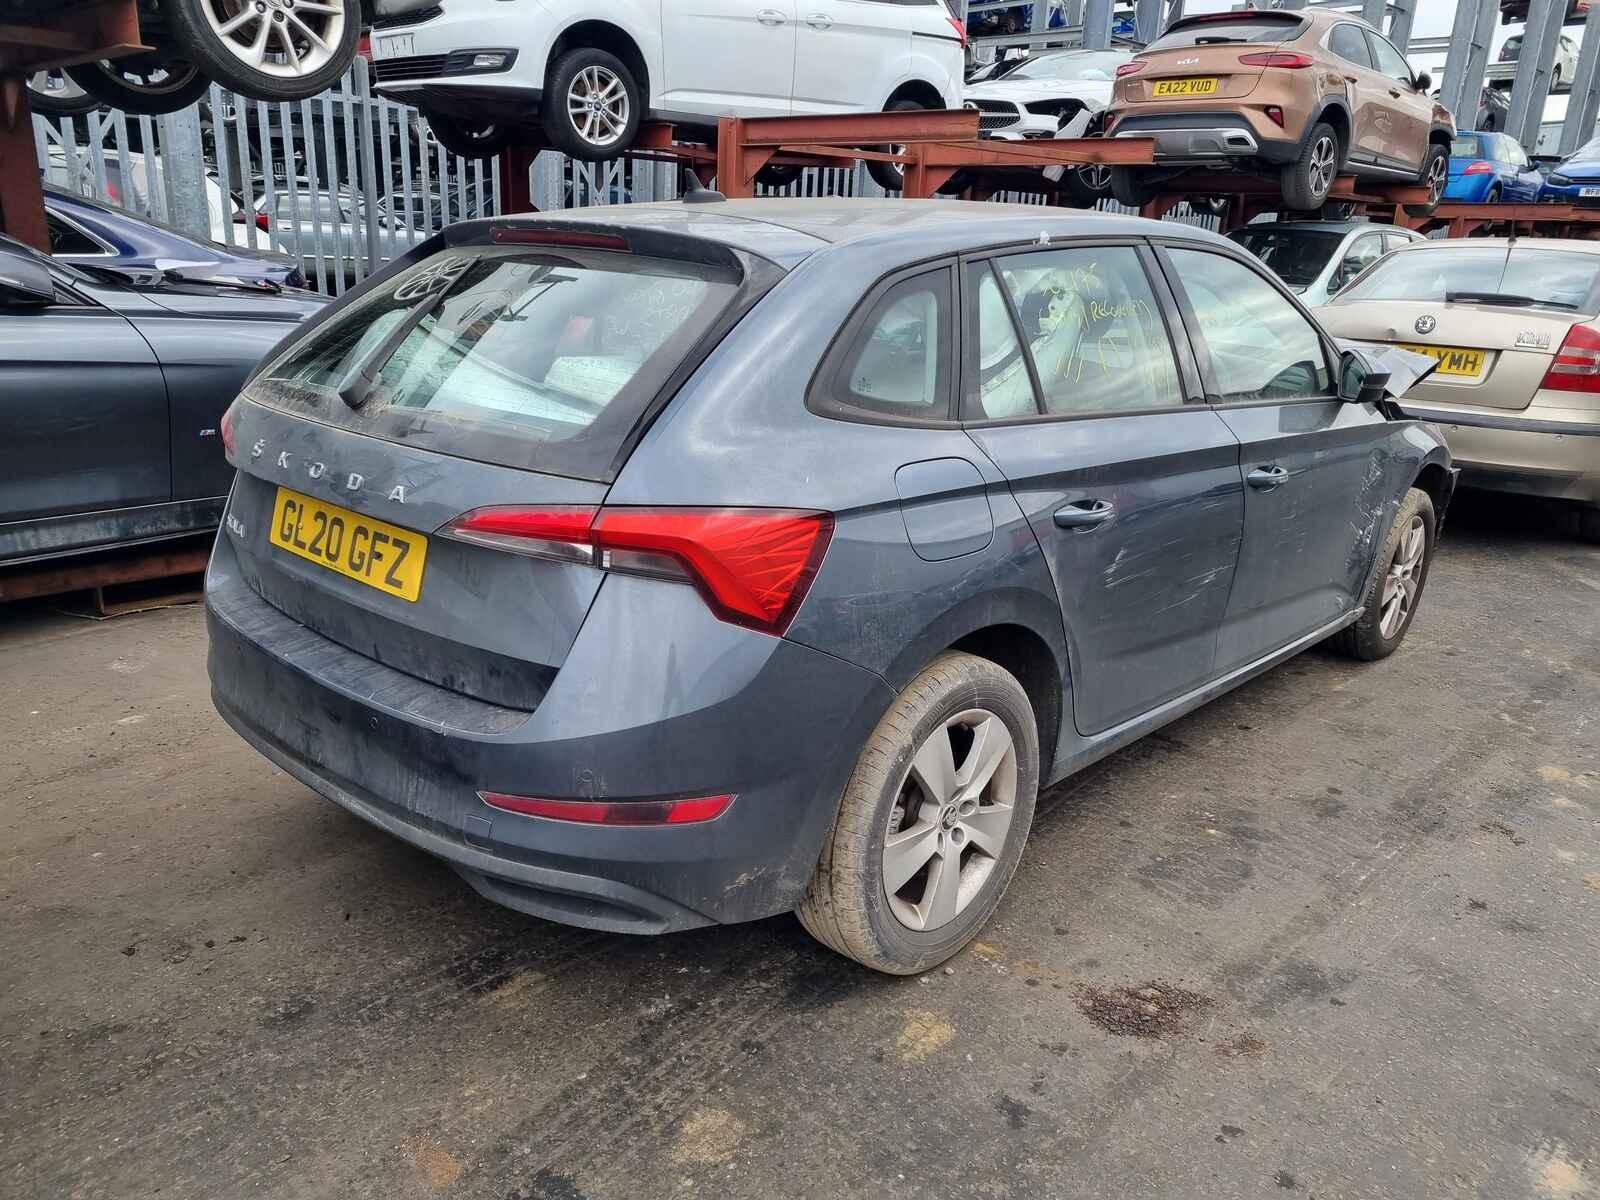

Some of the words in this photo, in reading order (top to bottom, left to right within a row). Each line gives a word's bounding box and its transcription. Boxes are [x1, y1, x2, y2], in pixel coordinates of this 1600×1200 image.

[1158, 81, 1187, 94] EA22
[1190, 80, 1212, 92] VUD
[1436, 350, 1479, 372] YMH
[251, 438, 408, 504] ŠKODA
[279, 499, 345, 563] GL20
[349, 525, 411, 589] GFZ
